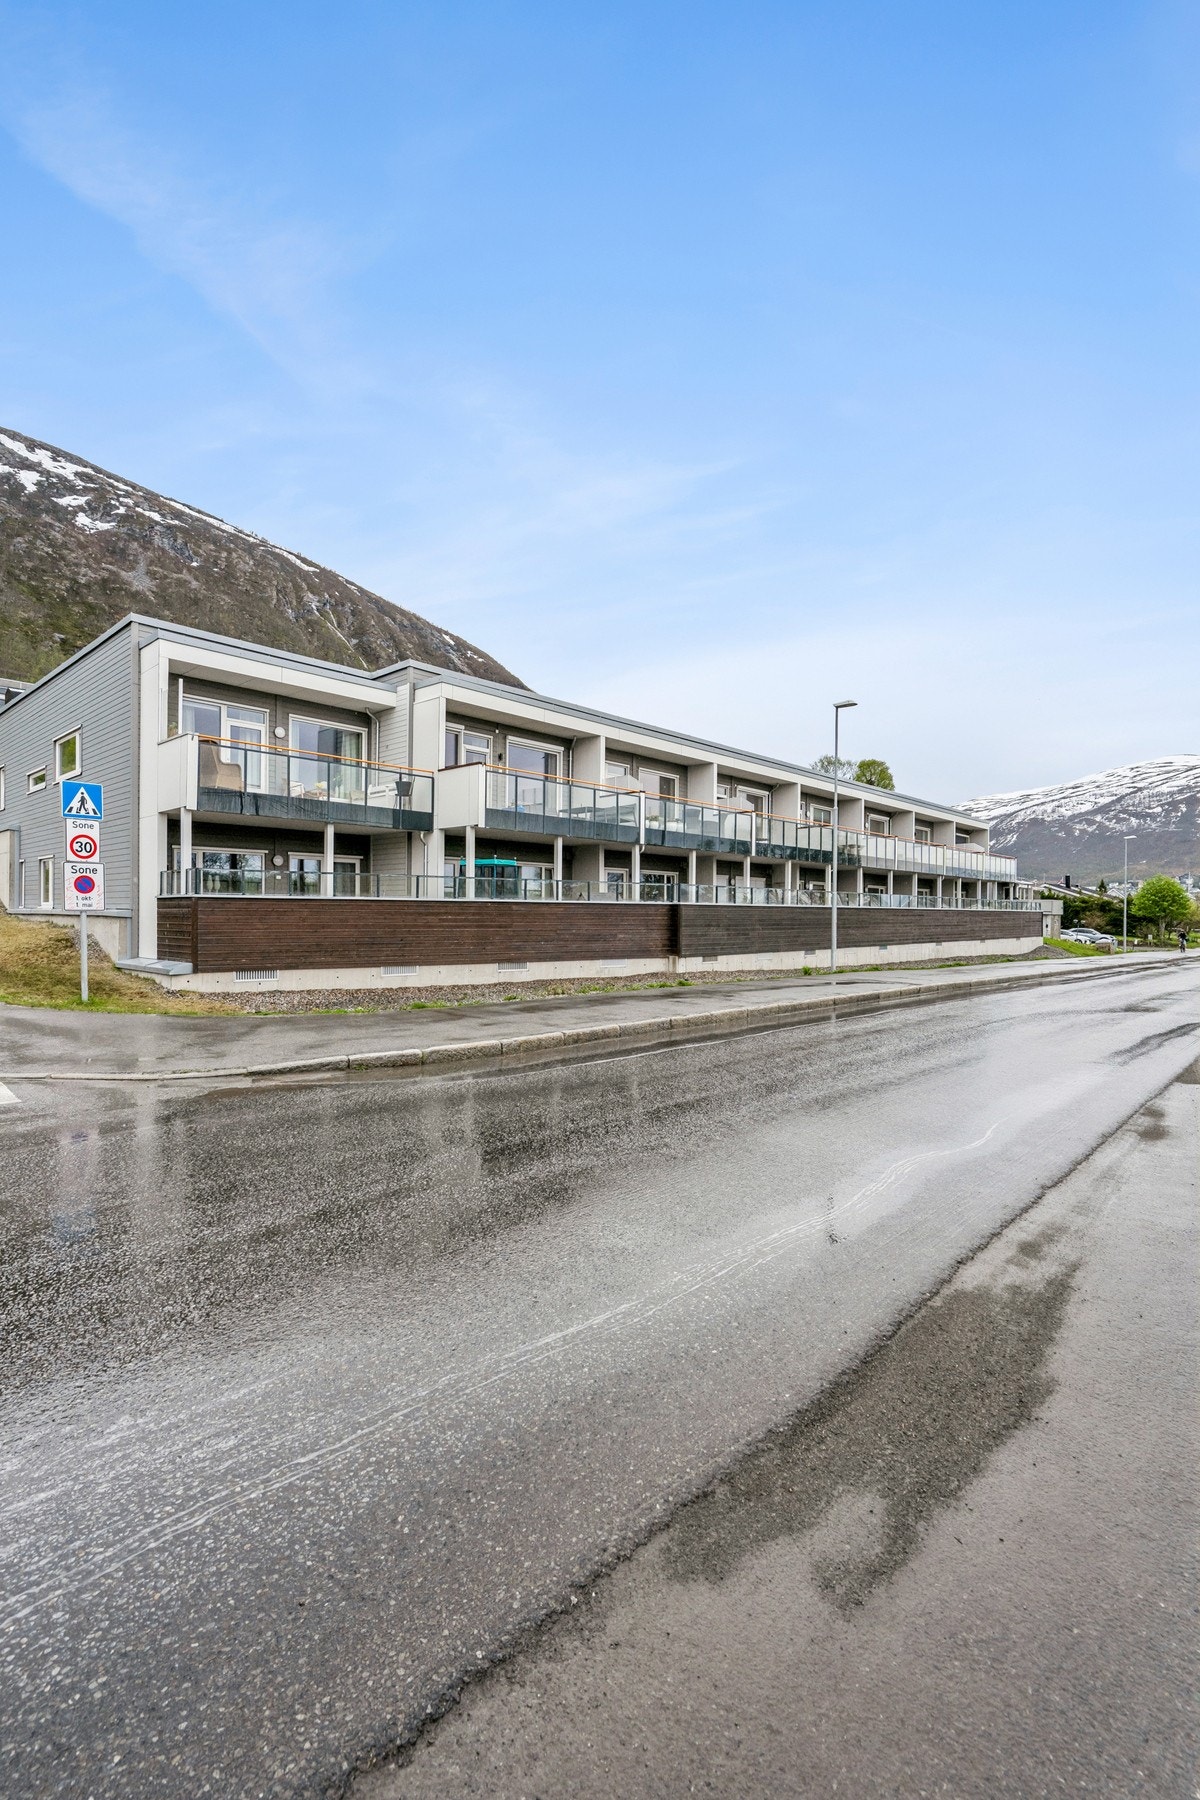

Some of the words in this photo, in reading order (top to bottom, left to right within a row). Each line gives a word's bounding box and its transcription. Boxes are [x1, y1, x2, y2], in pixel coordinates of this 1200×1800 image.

[72, 821, 94, 829] Sone
[75, 841, 92, 853] 30
[71, 865, 98, 874] Sone
